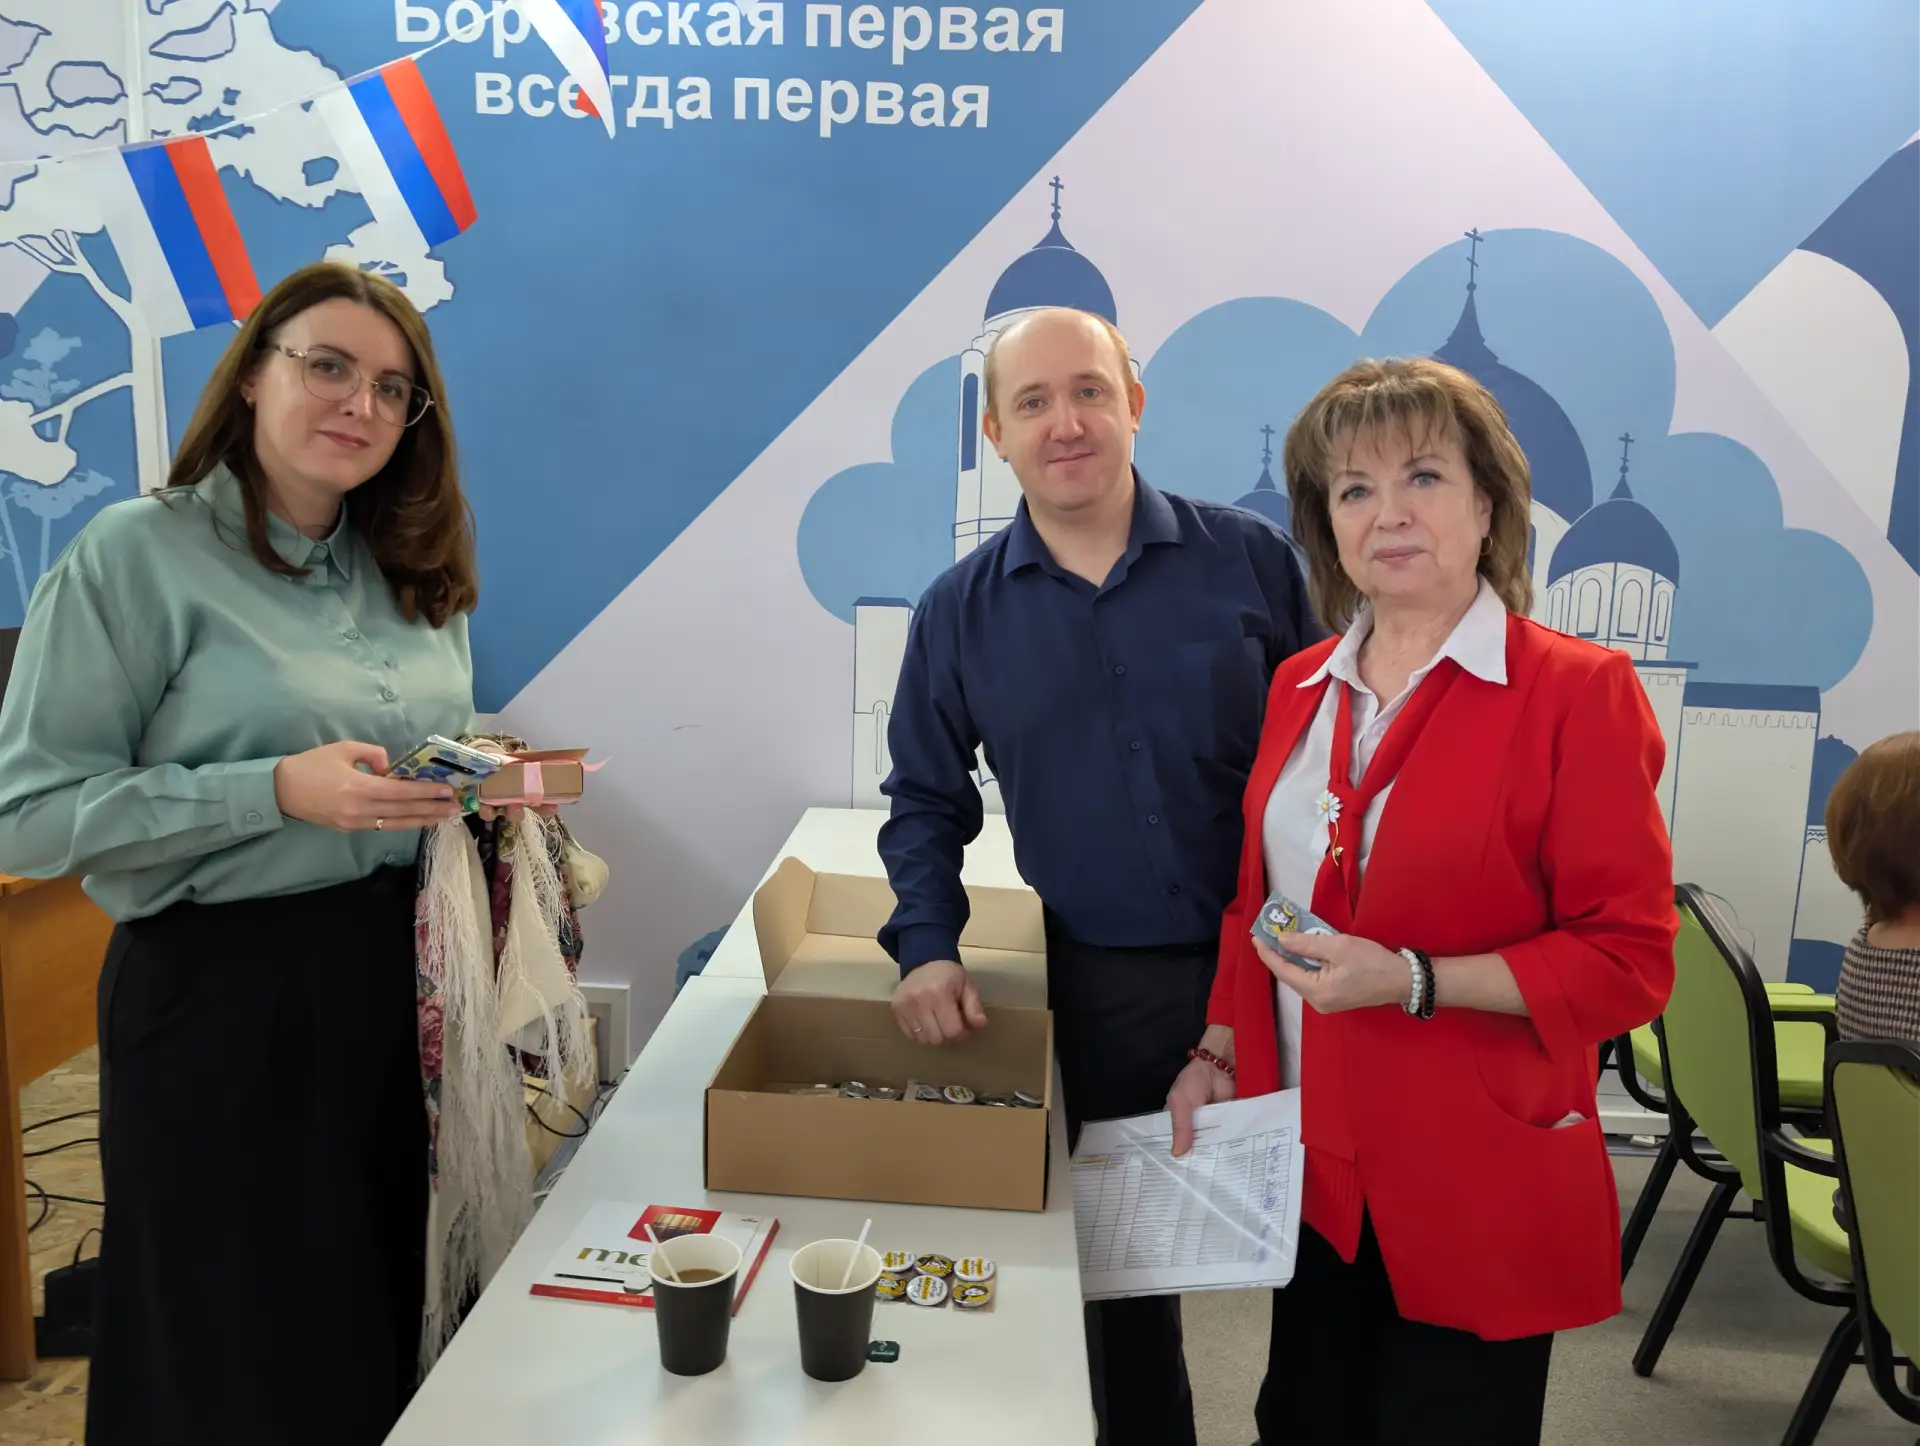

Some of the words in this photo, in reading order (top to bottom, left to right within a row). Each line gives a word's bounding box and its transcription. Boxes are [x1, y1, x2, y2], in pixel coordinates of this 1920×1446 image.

[394, 0, 784, 58] Борвская
[805, 3, 1064, 65] первая
[475, 72, 713, 129] вседа
[734, 77, 990, 138] первая
